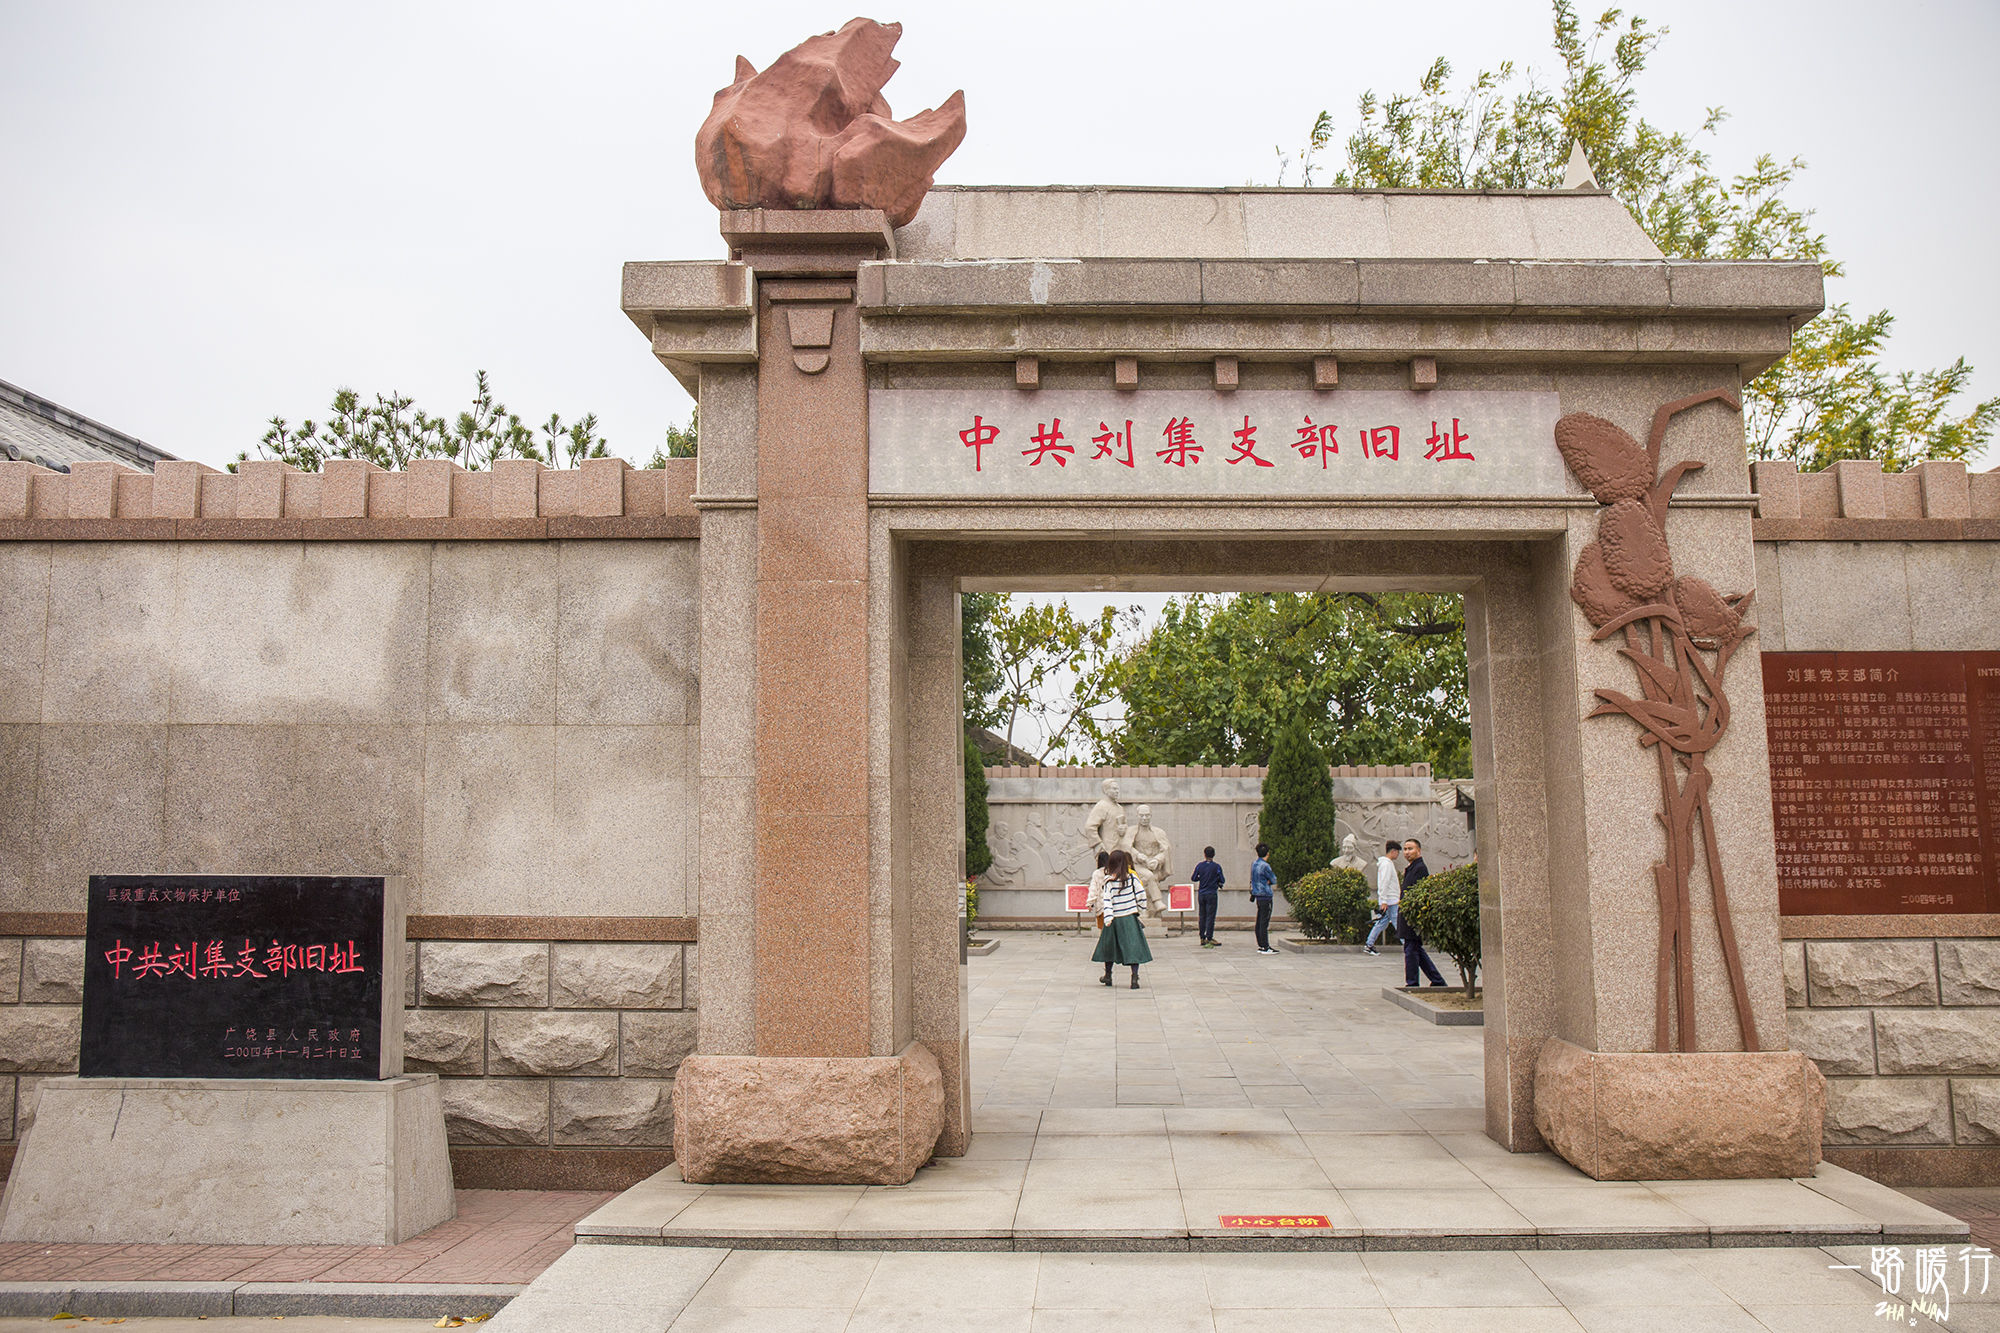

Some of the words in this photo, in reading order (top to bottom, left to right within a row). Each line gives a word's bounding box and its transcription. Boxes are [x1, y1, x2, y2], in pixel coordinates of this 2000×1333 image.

[958, 415, 1476, 472] 中共刘集支部旧址
[1787, 668, 1899, 682] 刘集党支部简介
[106, 887, 241, 903] 县级重点文物保护单位
[104, 939, 366, 980] 中共刘集支部旧址
[224, 1028, 362, 1041] 广饶县人民政府
[1231, 1218, 1319, 1226] 小心台阶
